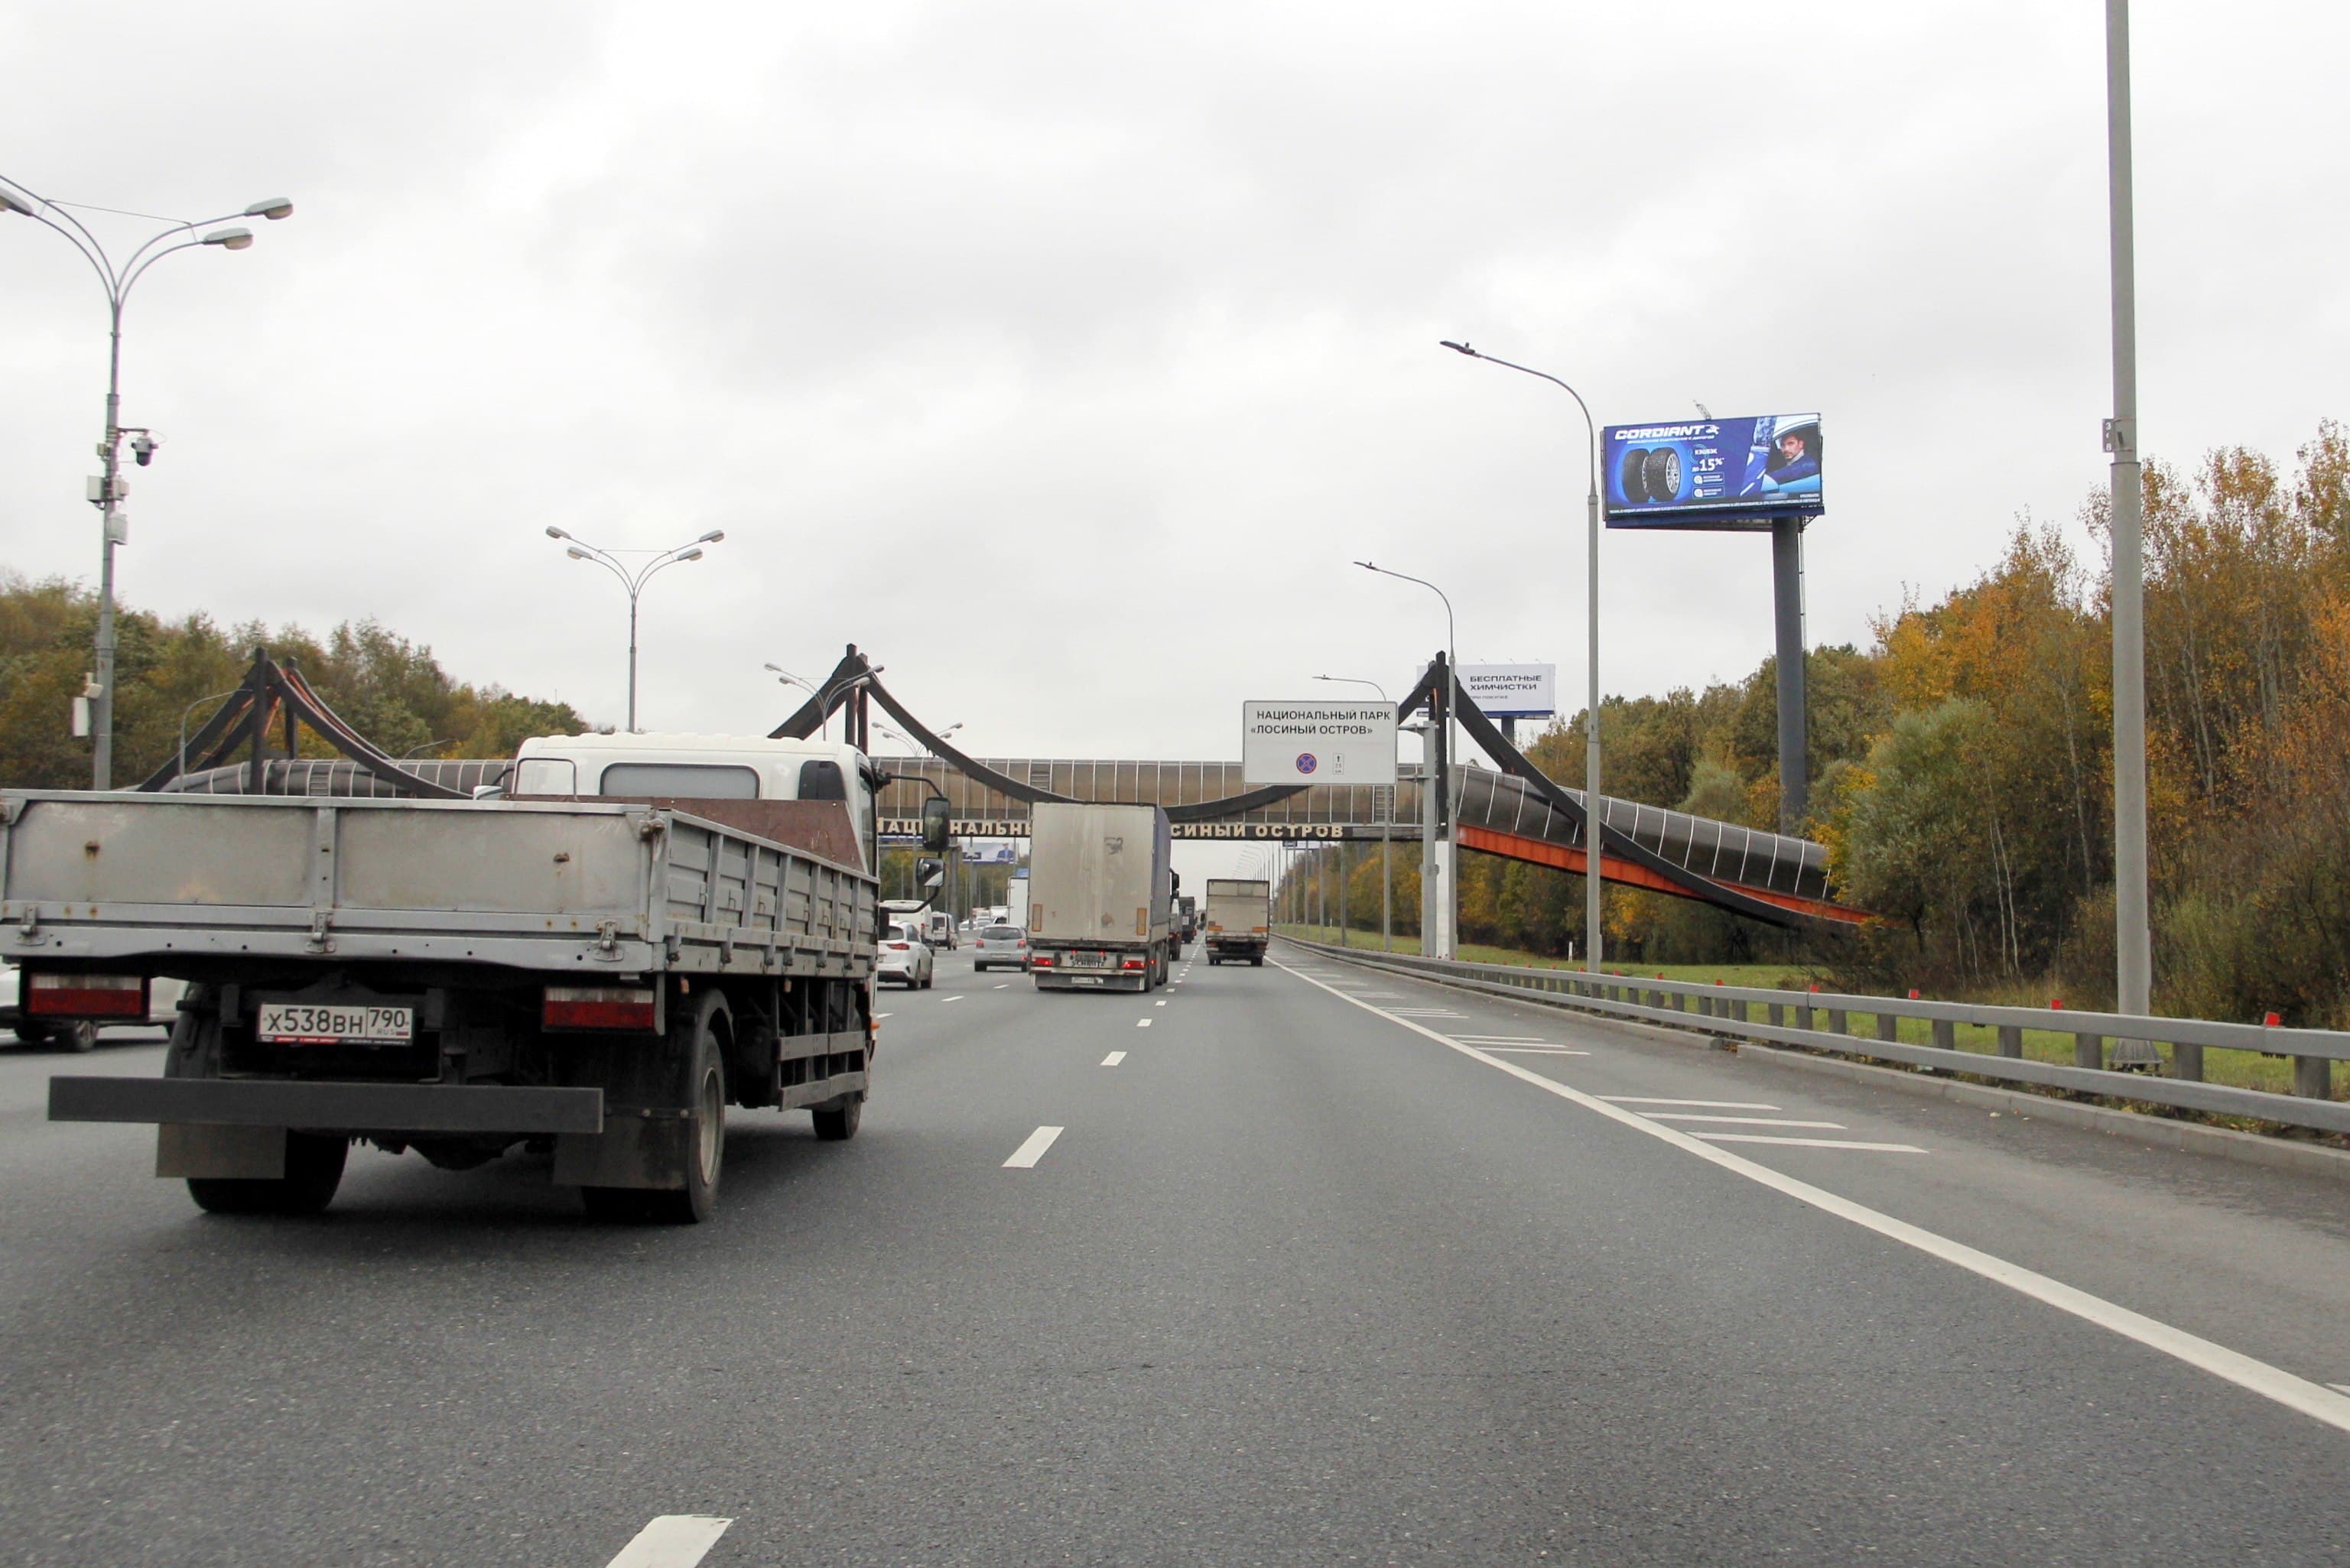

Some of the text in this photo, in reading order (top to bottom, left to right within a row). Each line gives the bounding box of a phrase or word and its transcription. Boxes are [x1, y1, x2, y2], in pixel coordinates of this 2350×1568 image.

[1615, 425, 1705, 440] CORDIANT
[1256, 709, 1391, 721] НАЦИОНАЛЬНЫЙ ПАРК
[1250, 723, 1373, 735] «ЛОСИНЫЙ ОСТРОВ»
[1255, 825, 1344, 838] ОСТРОВ
[268, 1008, 406, 1034] Х538ВН 790
